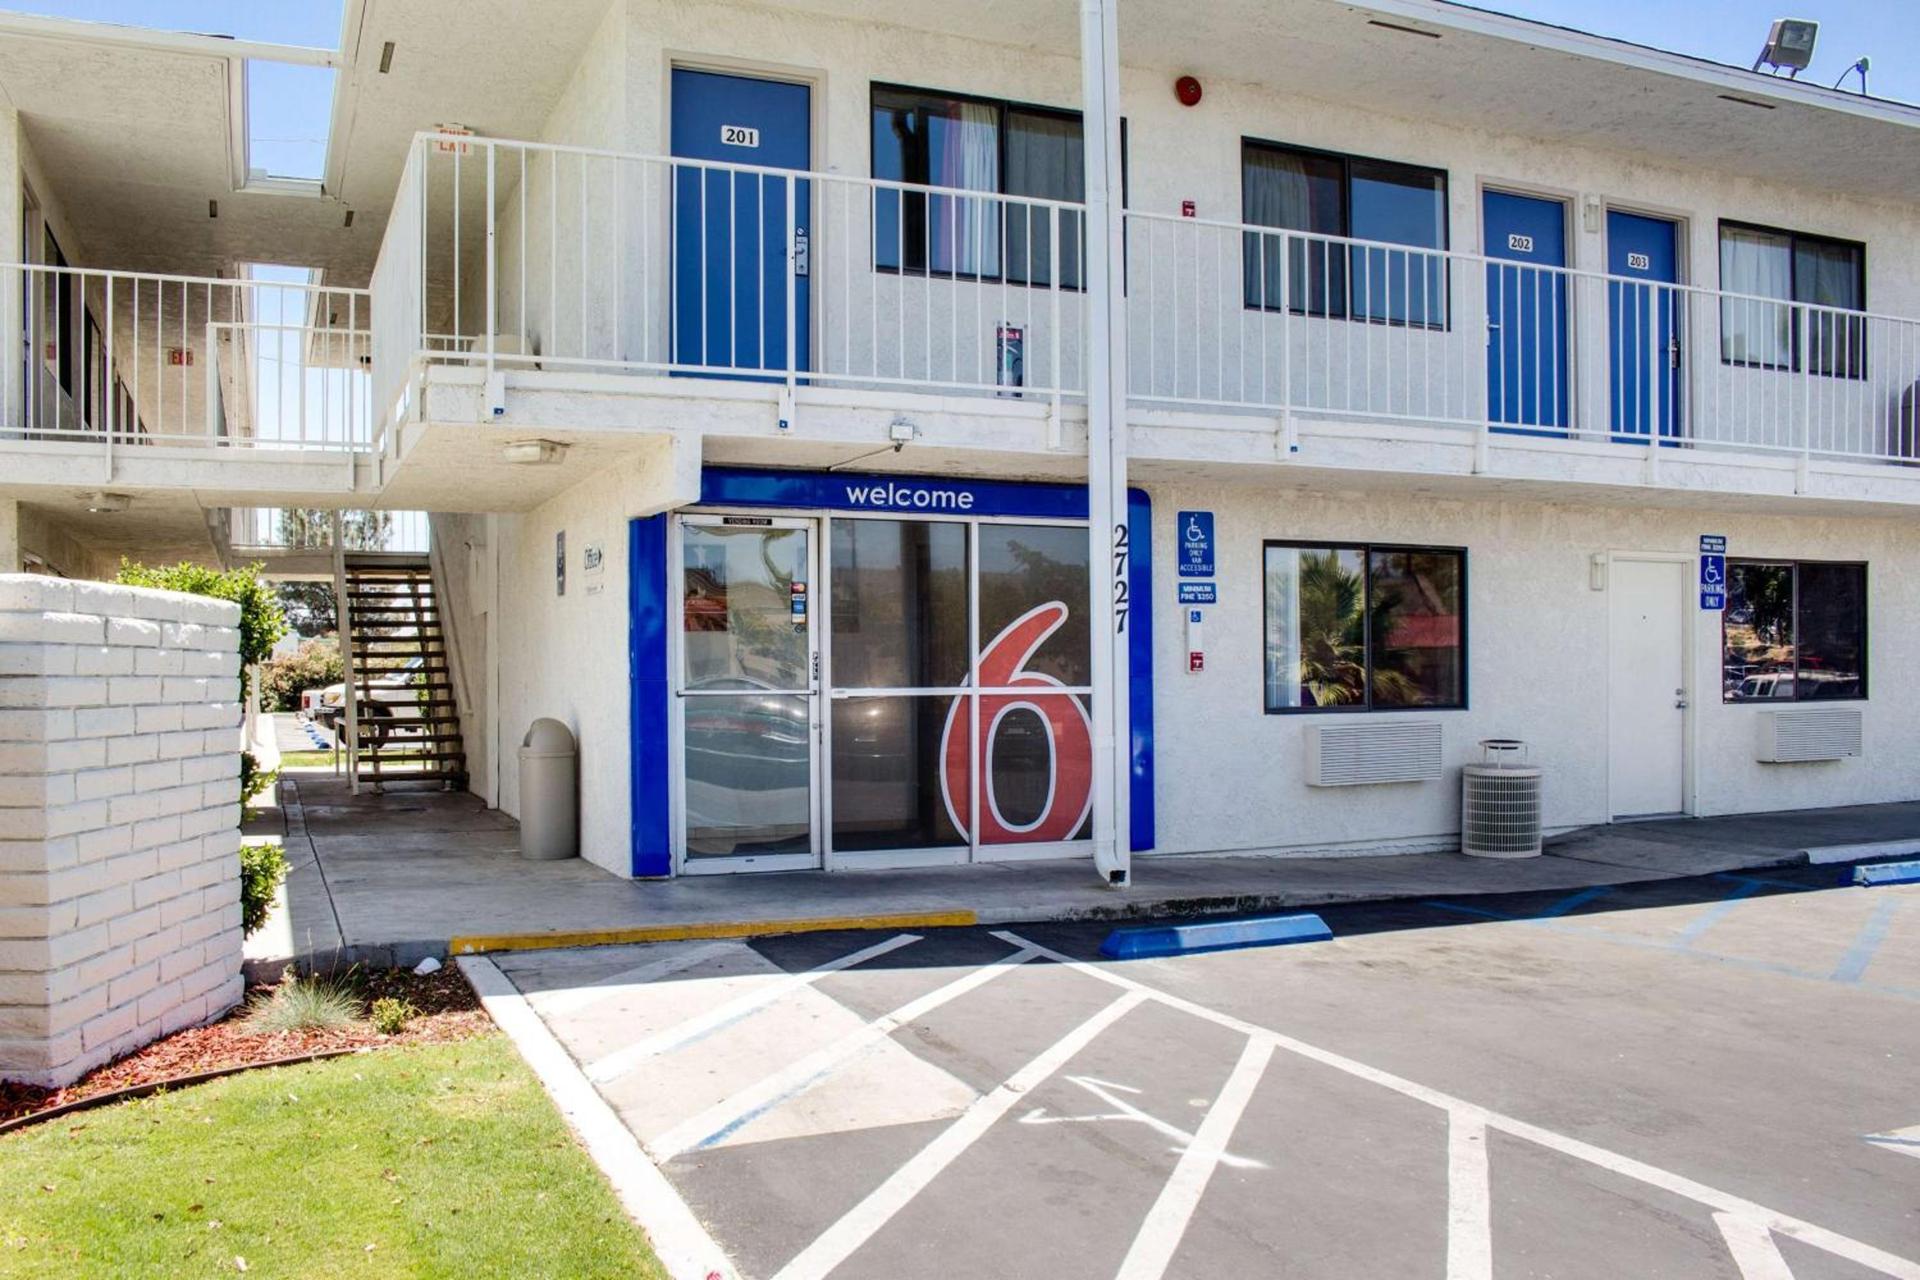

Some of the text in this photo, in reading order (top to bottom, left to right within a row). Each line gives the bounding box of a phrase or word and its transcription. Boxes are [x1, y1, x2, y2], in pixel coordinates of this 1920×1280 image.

[726, 128, 754, 145] 201
[1511, 236, 1531, 250] 202
[1630, 255, 1647, 268] 203
[846, 482, 974, 510] welcome
[1184, 542, 1208, 550] PARKING
[1180, 564, 1214, 572] ACCESSIBLE
[1114, 524, 1129, 634] 2727
[1701, 583, 1725, 594] PARKING
[1180, 593, 1196, 601] FINE
[1705, 595, 1720, 607] ONLY
[939, 600, 1095, 845] 6
